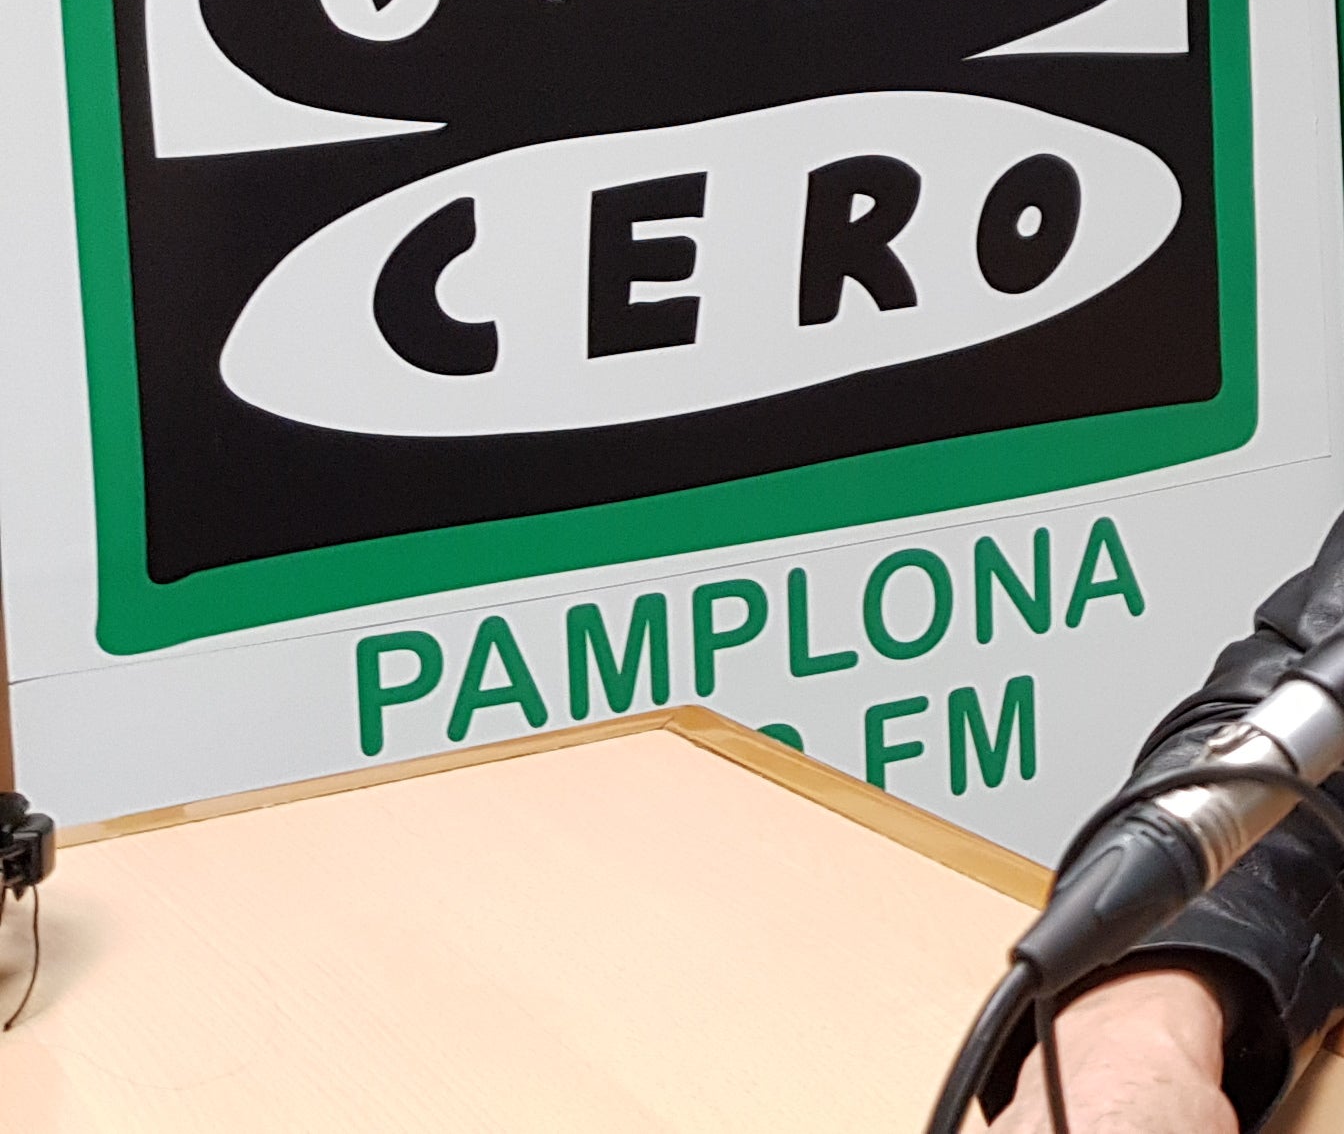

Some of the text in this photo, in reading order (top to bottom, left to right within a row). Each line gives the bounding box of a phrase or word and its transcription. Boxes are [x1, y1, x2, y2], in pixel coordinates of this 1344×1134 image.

[372, 153, 1081, 377] CERO
[355, 516, 1145, 757] PAMPLONA
[864, 674, 1037, 796] FM
